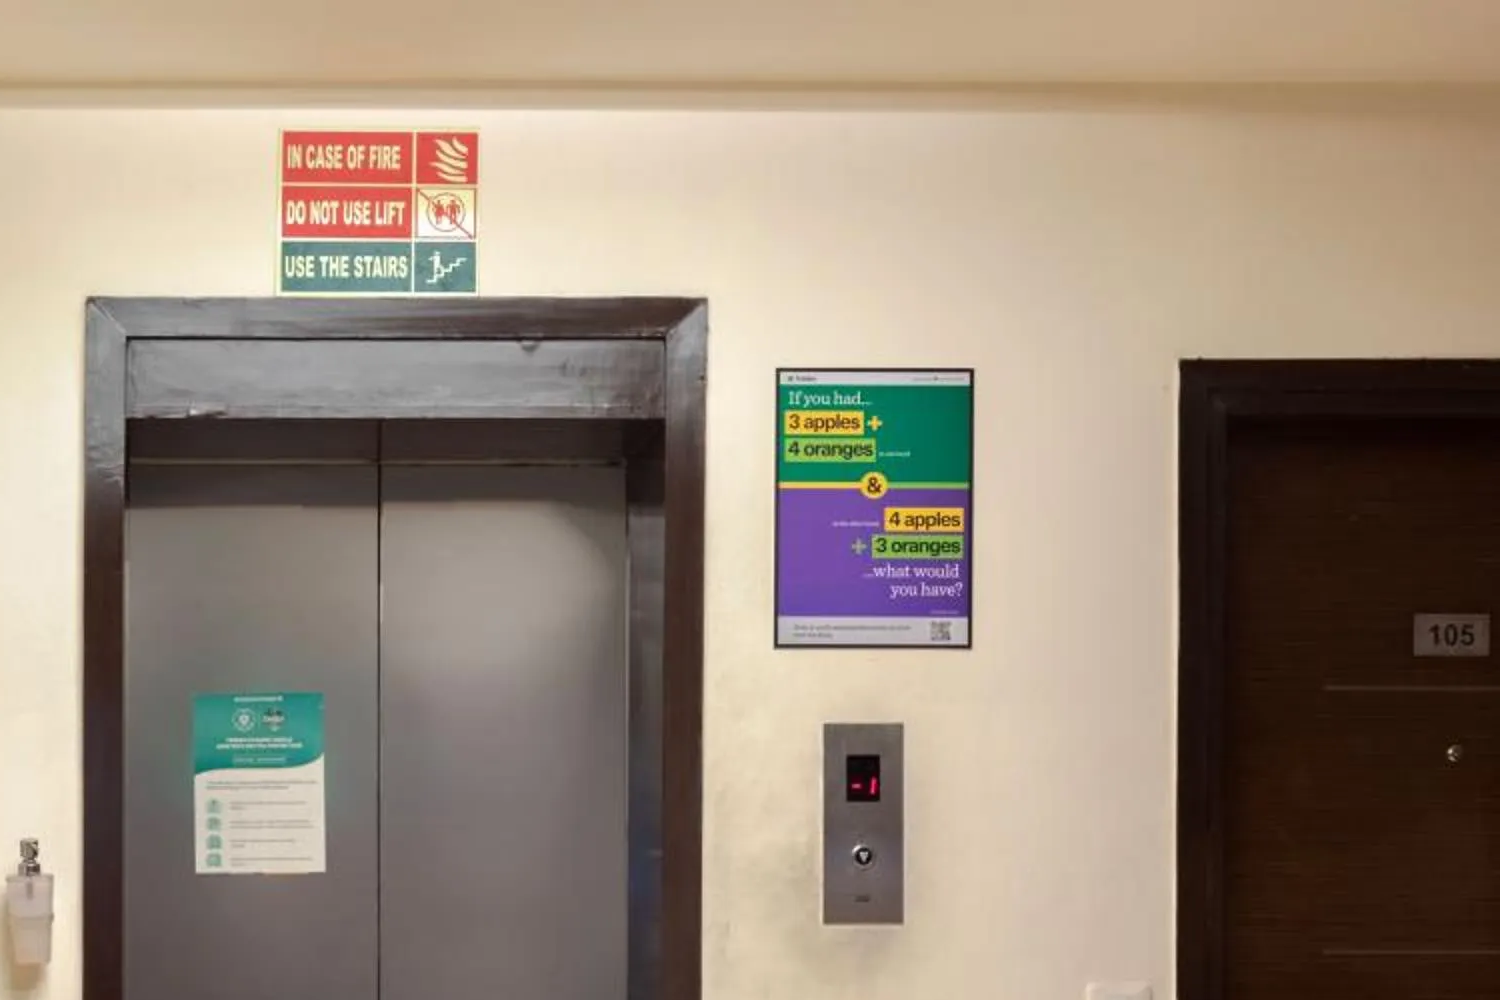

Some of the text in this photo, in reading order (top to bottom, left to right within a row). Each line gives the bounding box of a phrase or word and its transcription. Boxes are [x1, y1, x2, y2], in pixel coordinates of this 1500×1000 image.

[287, 144, 401, 170] IN CASE OF FIRE
[286, 200, 405, 225] DO NOT USE LIFT
[285, 255, 408, 278] USE THE STAIRS
[788, 390, 803, 405] If
[803, 394, 831, 409] you
[789, 414, 800, 430] 3
[803, 414, 861, 433] apples
[788, 442, 799, 456] 4
[804, 445, 873, 460] oranges
[867, 477, 881, 494] &
[889, 512, 900, 527] 4
[904, 512, 961, 531] apples
[875, 538, 887, 553] 3
[891, 541, 961, 556] oranges
[914, 564, 960, 578] would
[889, 583, 963, 599] you have?
[1429, 624, 1475, 647] 105
